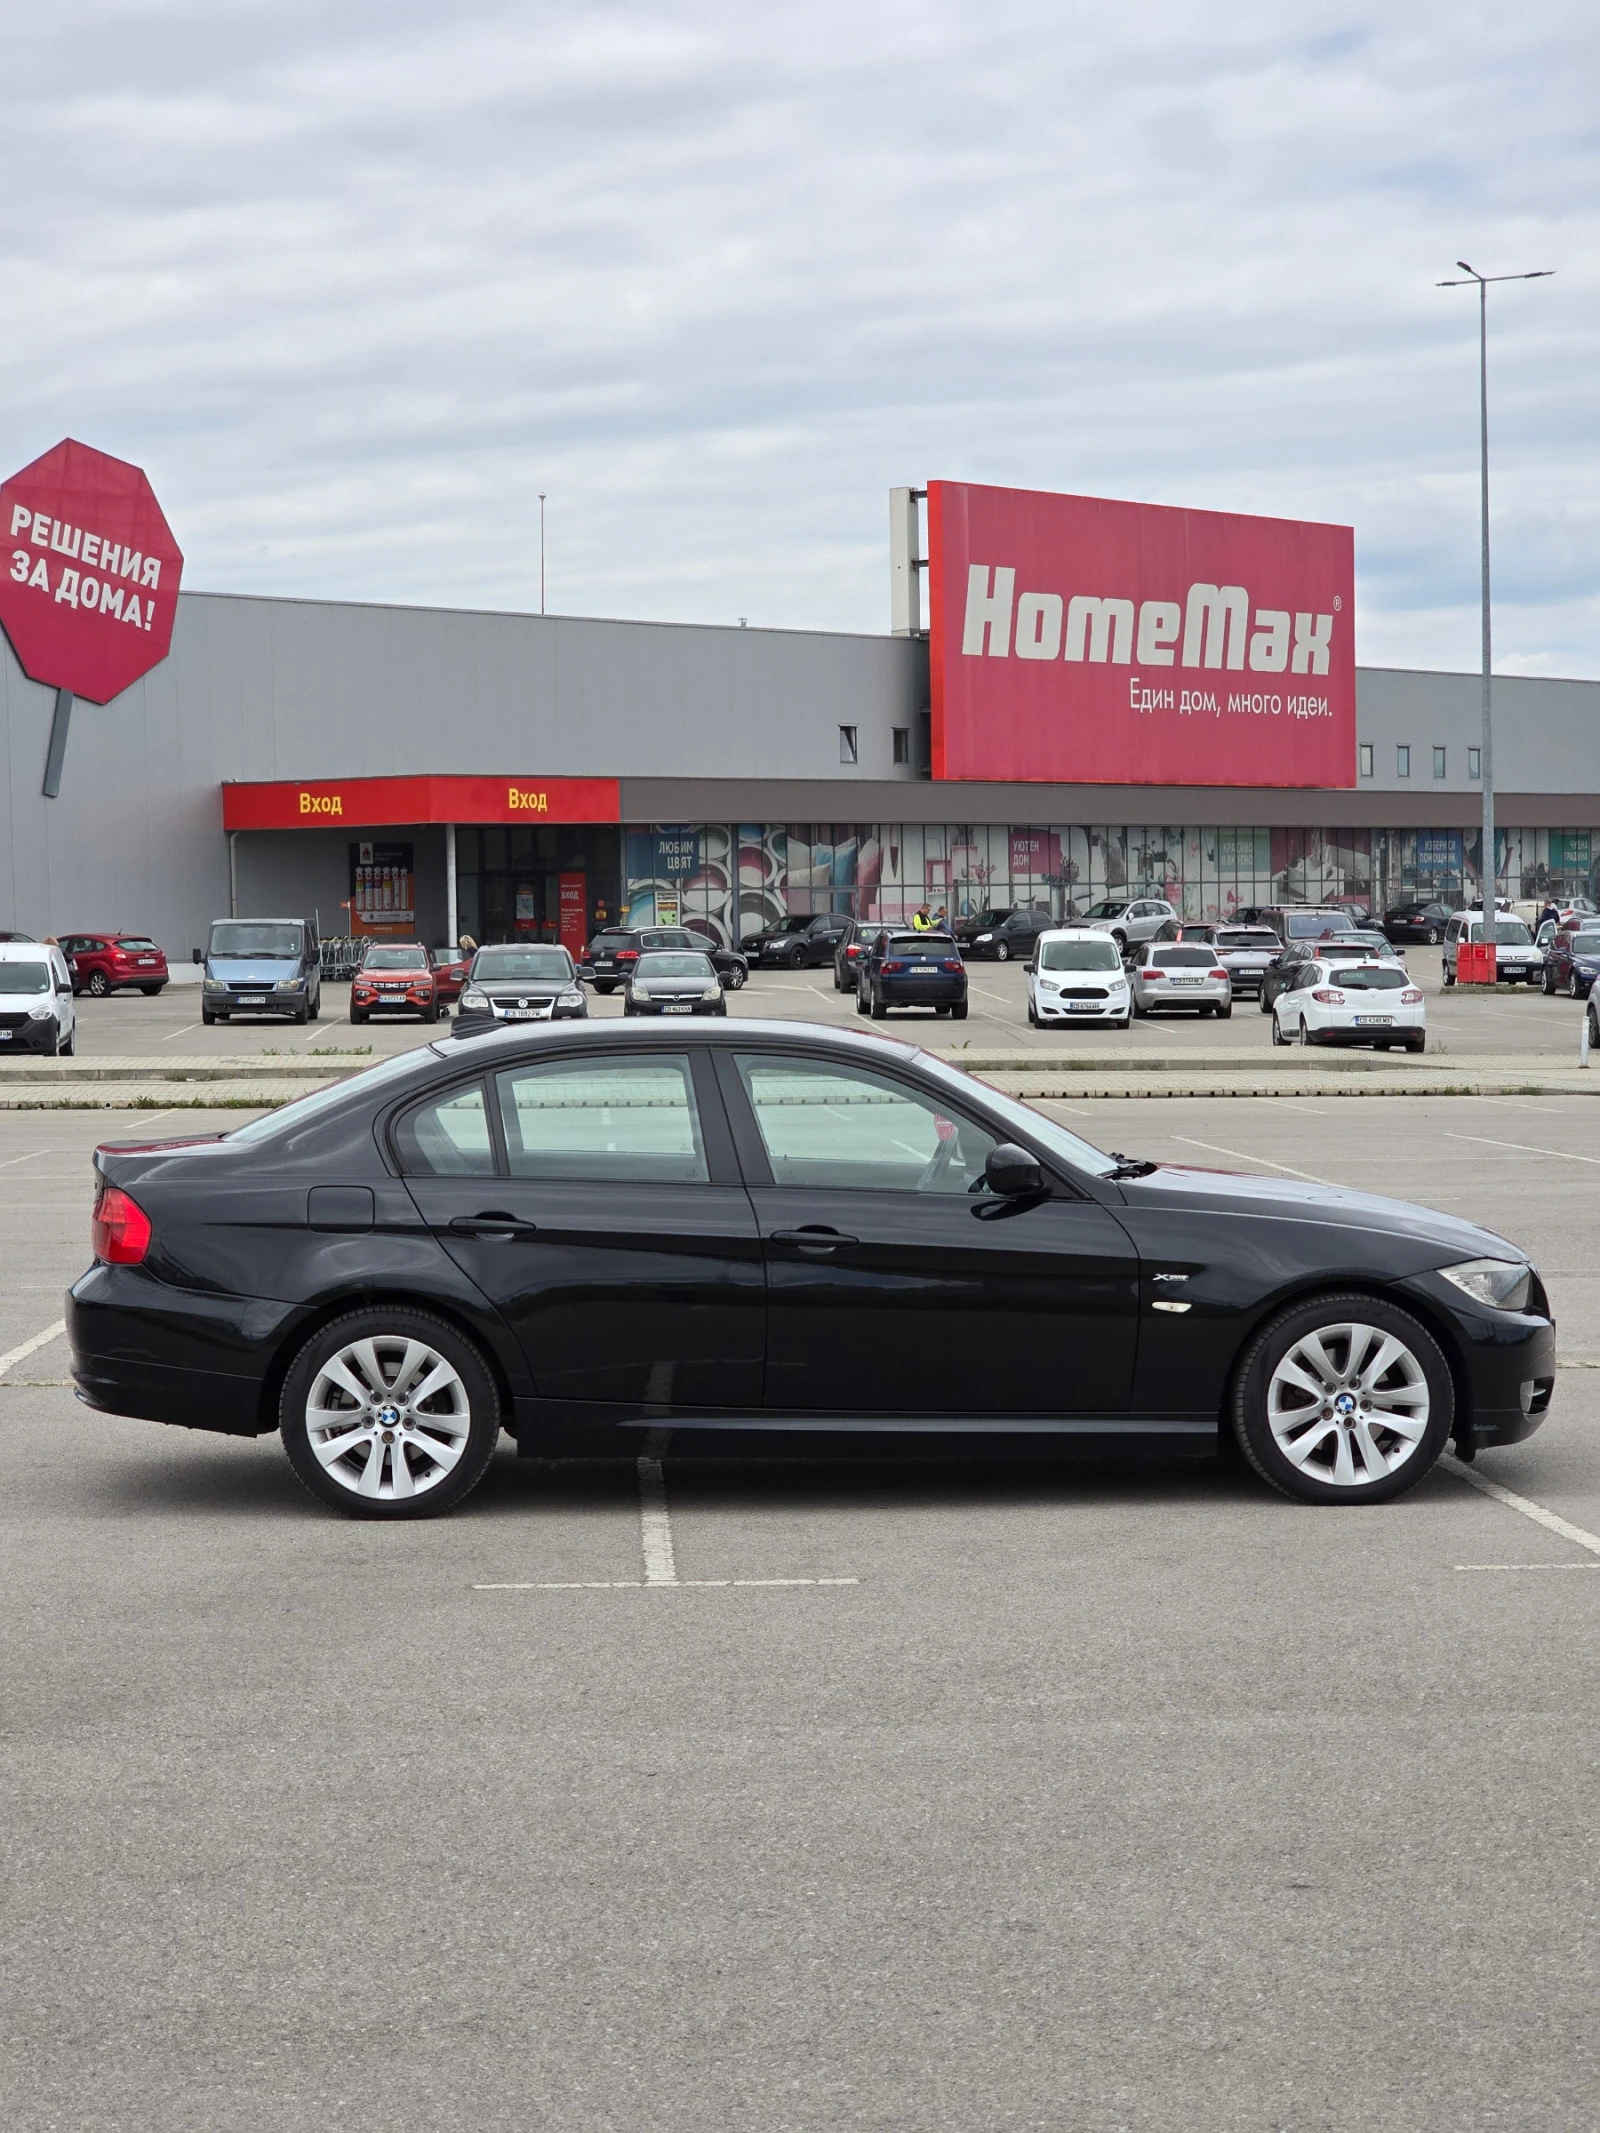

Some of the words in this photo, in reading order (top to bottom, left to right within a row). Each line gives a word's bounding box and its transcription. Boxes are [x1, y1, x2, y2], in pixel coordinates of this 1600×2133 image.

[10, 504, 161, 590] РЕШЕНИЯ
[10, 550, 50, 593] ЗА
[55, 567, 156, 632] ДОМА!
[962, 564, 1334, 676] HomeMax
[1130, 678, 1174, 713] Един
[1179, 690, 1221, 718] дом,
[1227, 692, 1281, 715] много
[1287, 695, 1333, 719] идеи.
[300, 792, 343, 816] Вход
[508, 788, 548, 812] Вход
[659, 841, 694, 854] ЛЮБИМ
[1012, 840, 1039, 852] УЮТЕН
[667, 856, 692, 871] ЦВЯТ
[1013, 854, 1030, 868] ДОМ
[561, 891, 579, 900] ВХОД
